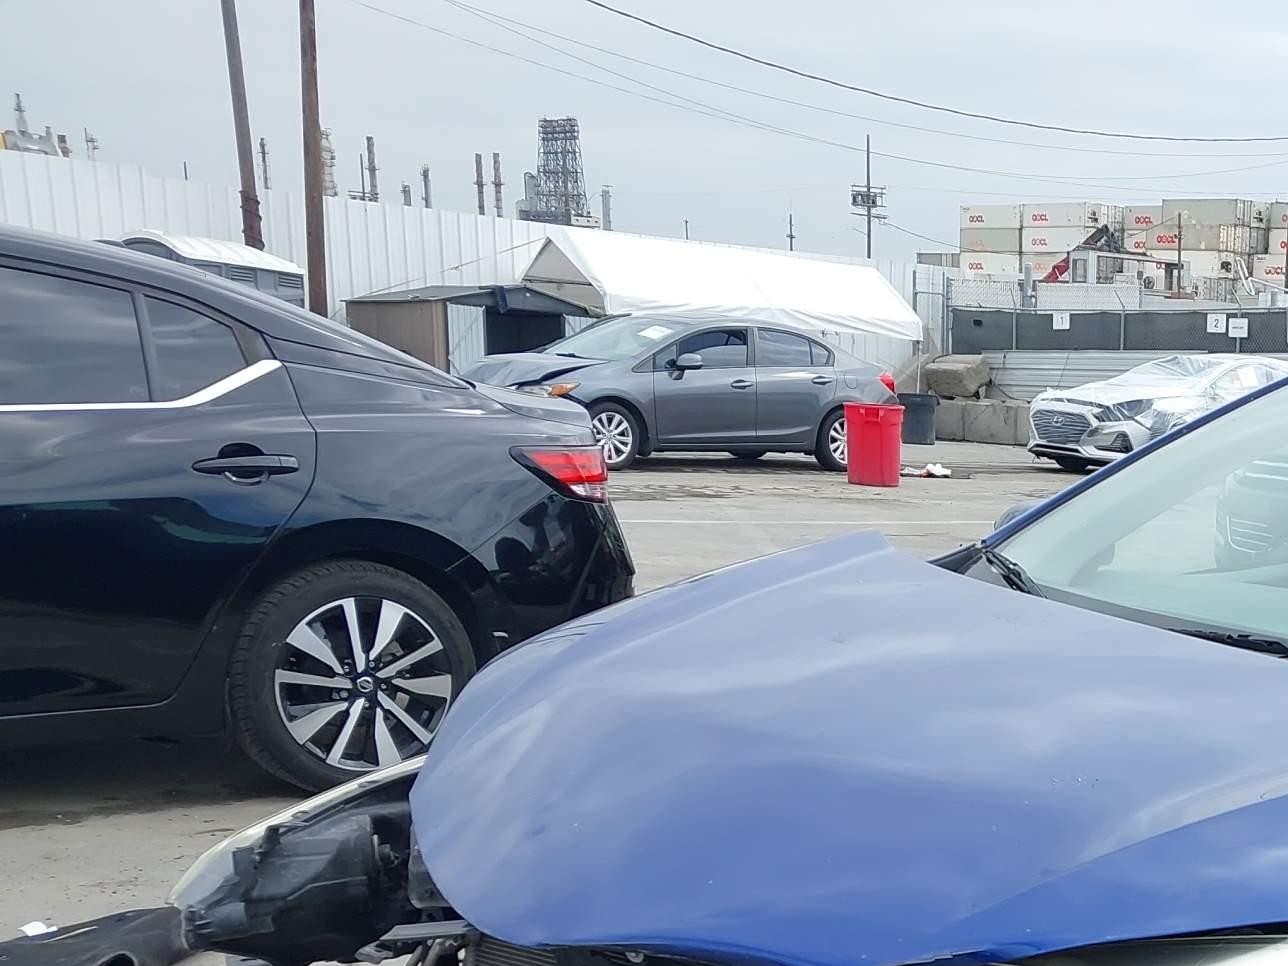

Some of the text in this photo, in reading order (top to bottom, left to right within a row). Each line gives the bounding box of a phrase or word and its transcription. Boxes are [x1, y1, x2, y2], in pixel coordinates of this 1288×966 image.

[968, 215, 985, 223] OOCL
[1032, 213, 1048, 222] OOCL
[1135, 216, 1153, 225] OOCL
[1031, 238, 1048, 246] OOCL
[1156, 235, 1177, 244] OOCL
[968, 262, 984, 270] OOCL
